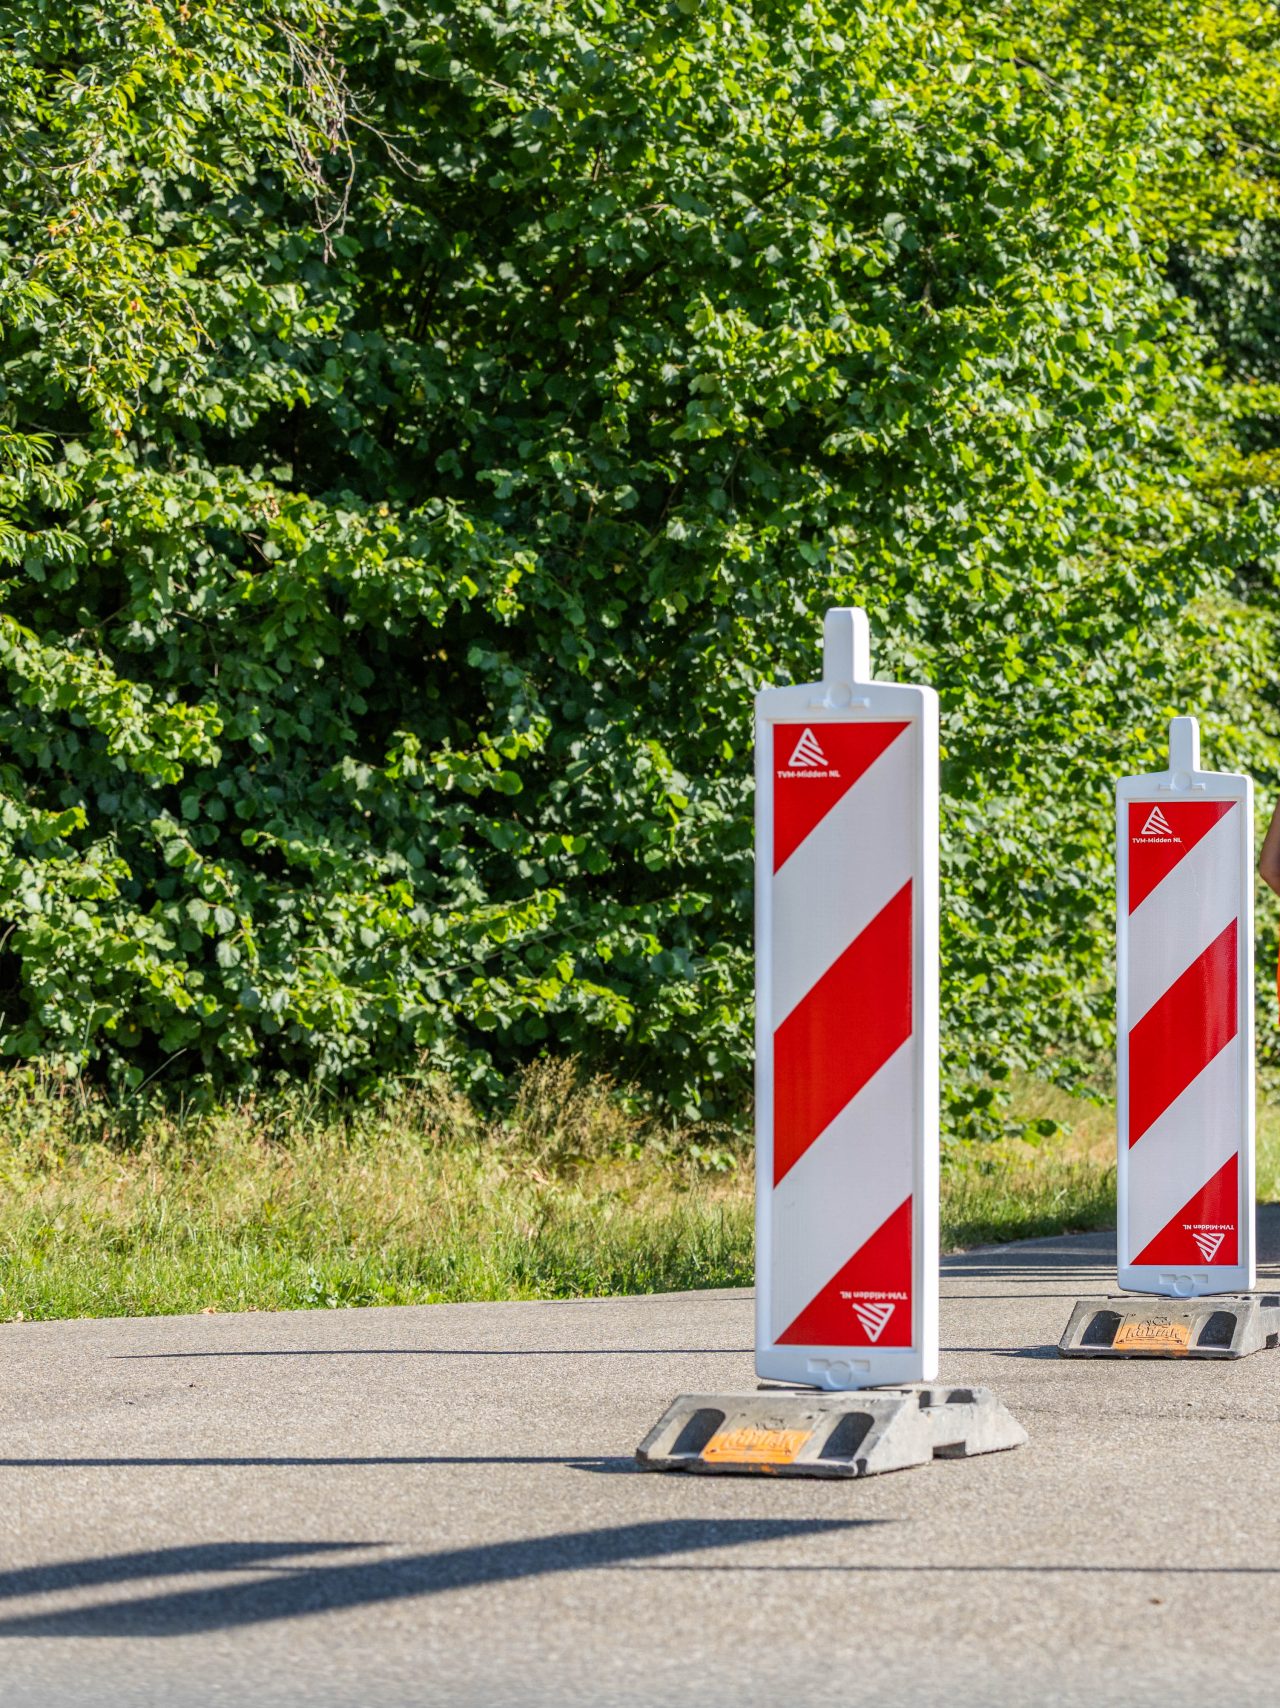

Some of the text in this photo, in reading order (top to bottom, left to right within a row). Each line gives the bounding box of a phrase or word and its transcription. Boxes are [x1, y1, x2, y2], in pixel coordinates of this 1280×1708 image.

[777, 770, 841, 778] TVM-Midden NL
[840, 1291, 908, 1300] TVM-Midden NL
